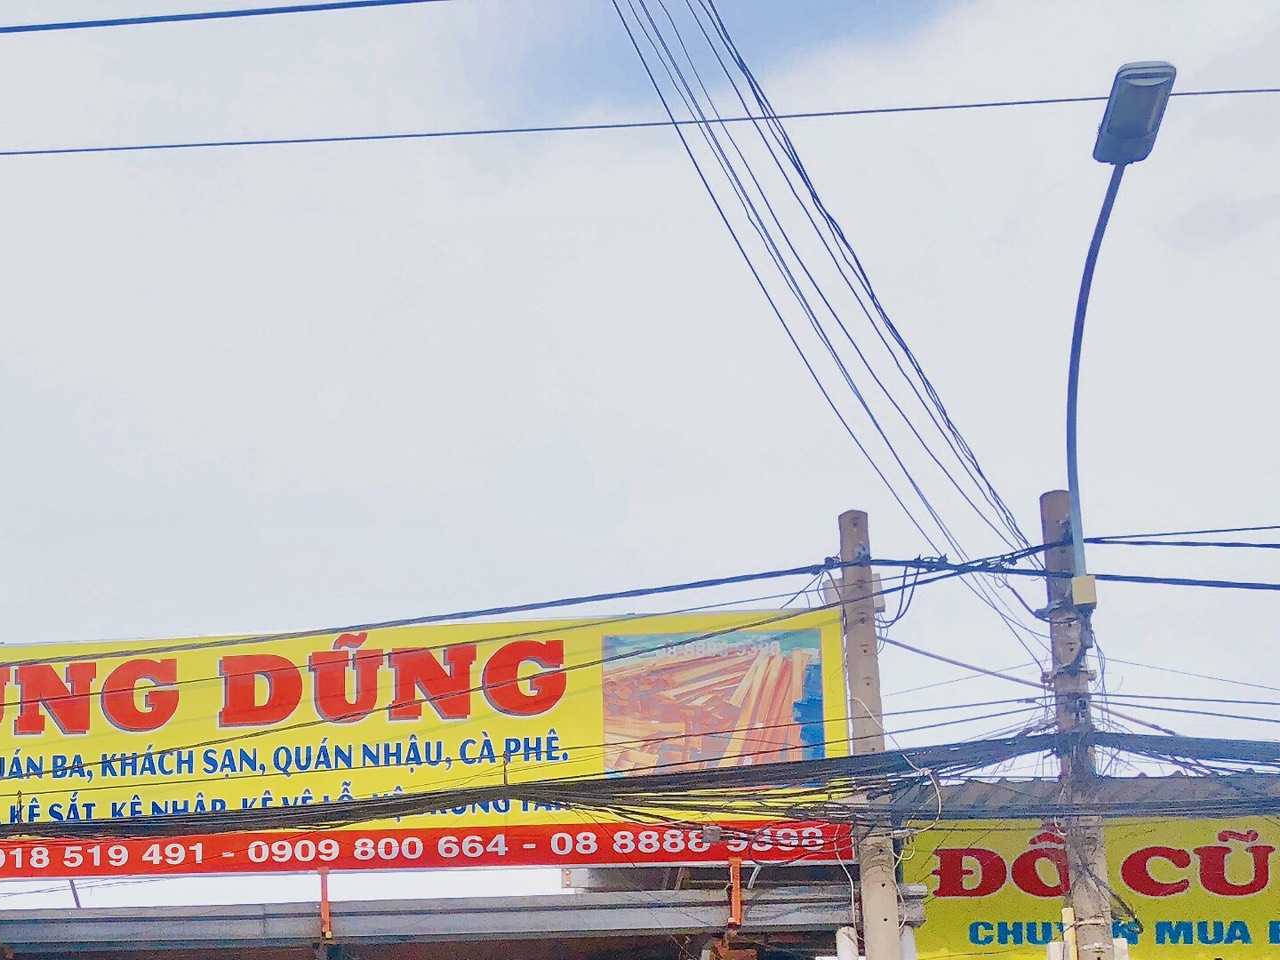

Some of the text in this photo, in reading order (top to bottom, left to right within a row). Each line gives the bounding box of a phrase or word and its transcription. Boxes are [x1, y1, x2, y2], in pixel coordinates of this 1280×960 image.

[218, 631, 568, 728] DŨNG
[100, 744, 195, 778] KHÁCH
[202, 747, 266, 781] SẠN,
[272, 736, 353, 778] QUÁN
[361, 734, 453, 773] NHẬU,
[459, 731, 500, 765] CÀ
[504, 729, 570, 763] PHÊ.
[63, 844, 129, 868] 519
[142, 842, 204, 865] 491
[247, 839, 340, 863] 0909
[354, 837, 424, 860] 800
[437, 834, 508, 858] 664
[550, 832, 598, 855] 08
[1120, 829, 1277, 897] CŨ
[1155, 920, 1254, 945] MUA
